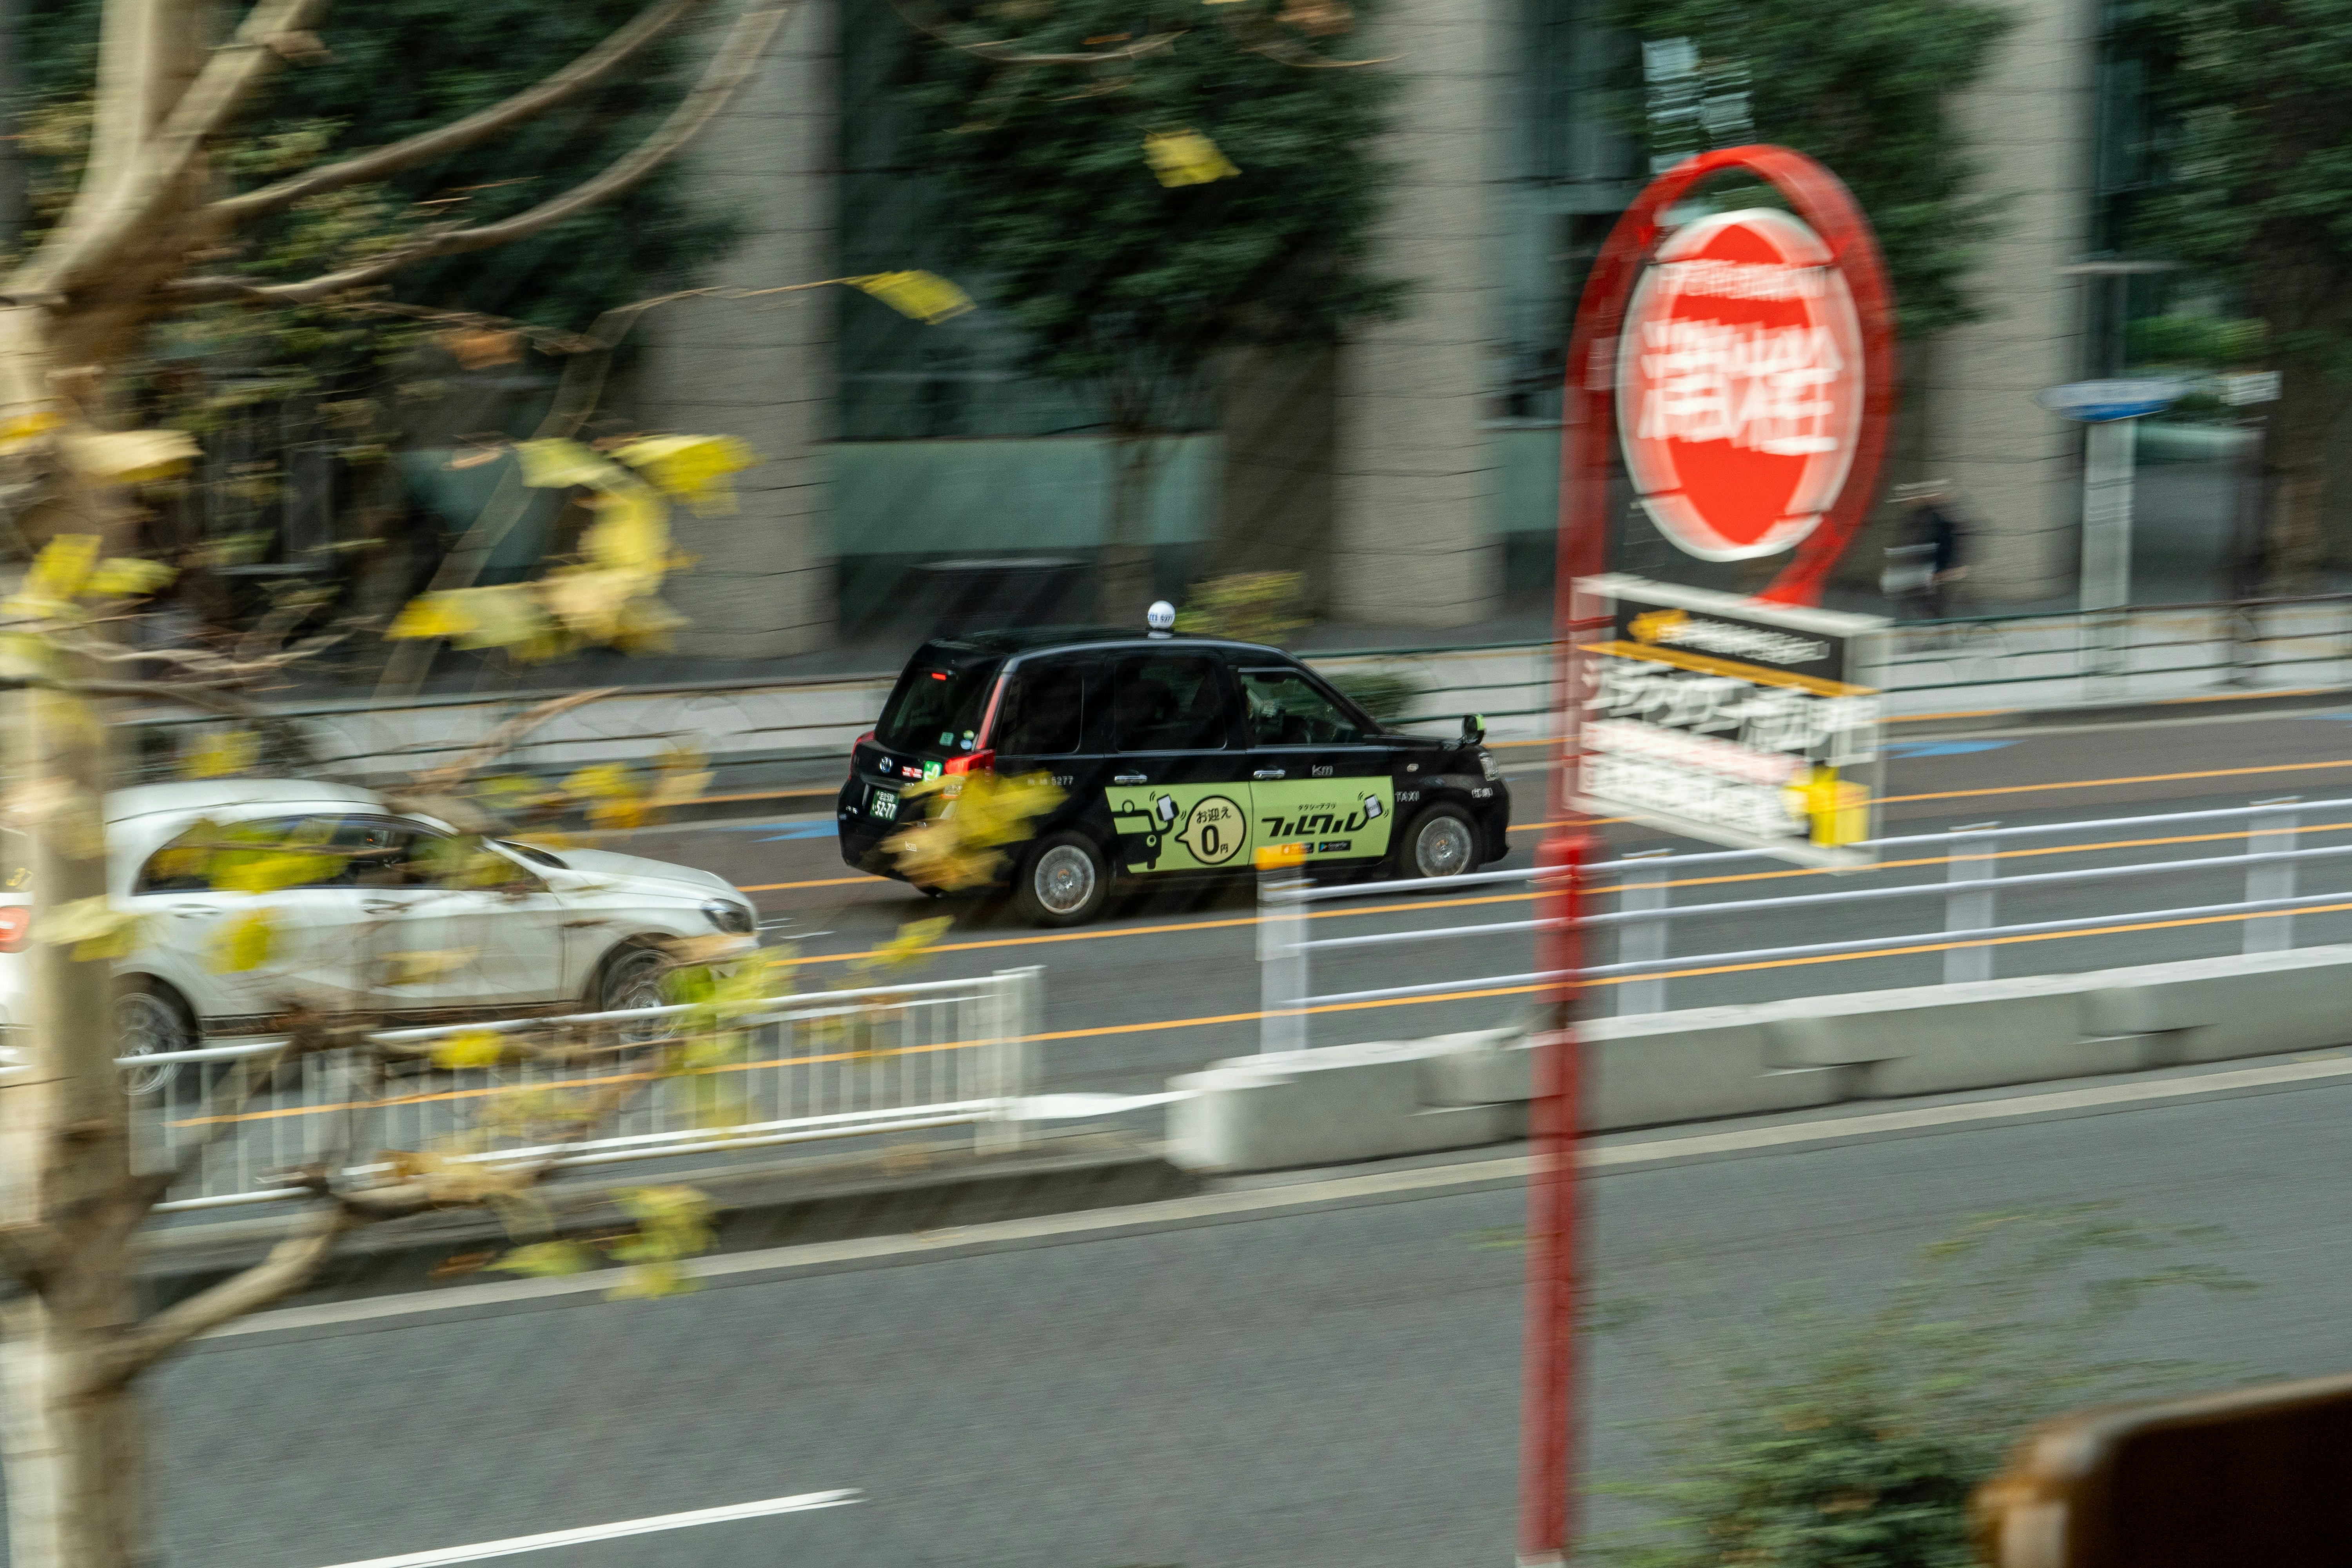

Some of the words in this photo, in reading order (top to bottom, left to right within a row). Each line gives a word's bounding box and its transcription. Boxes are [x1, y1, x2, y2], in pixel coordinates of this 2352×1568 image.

[1395, 791, 1420, 802] TAXI
[1196, 806, 1232, 824] お迎え
[1261, 811, 1369, 838] フルクル
[905, 840, 917, 852] km
